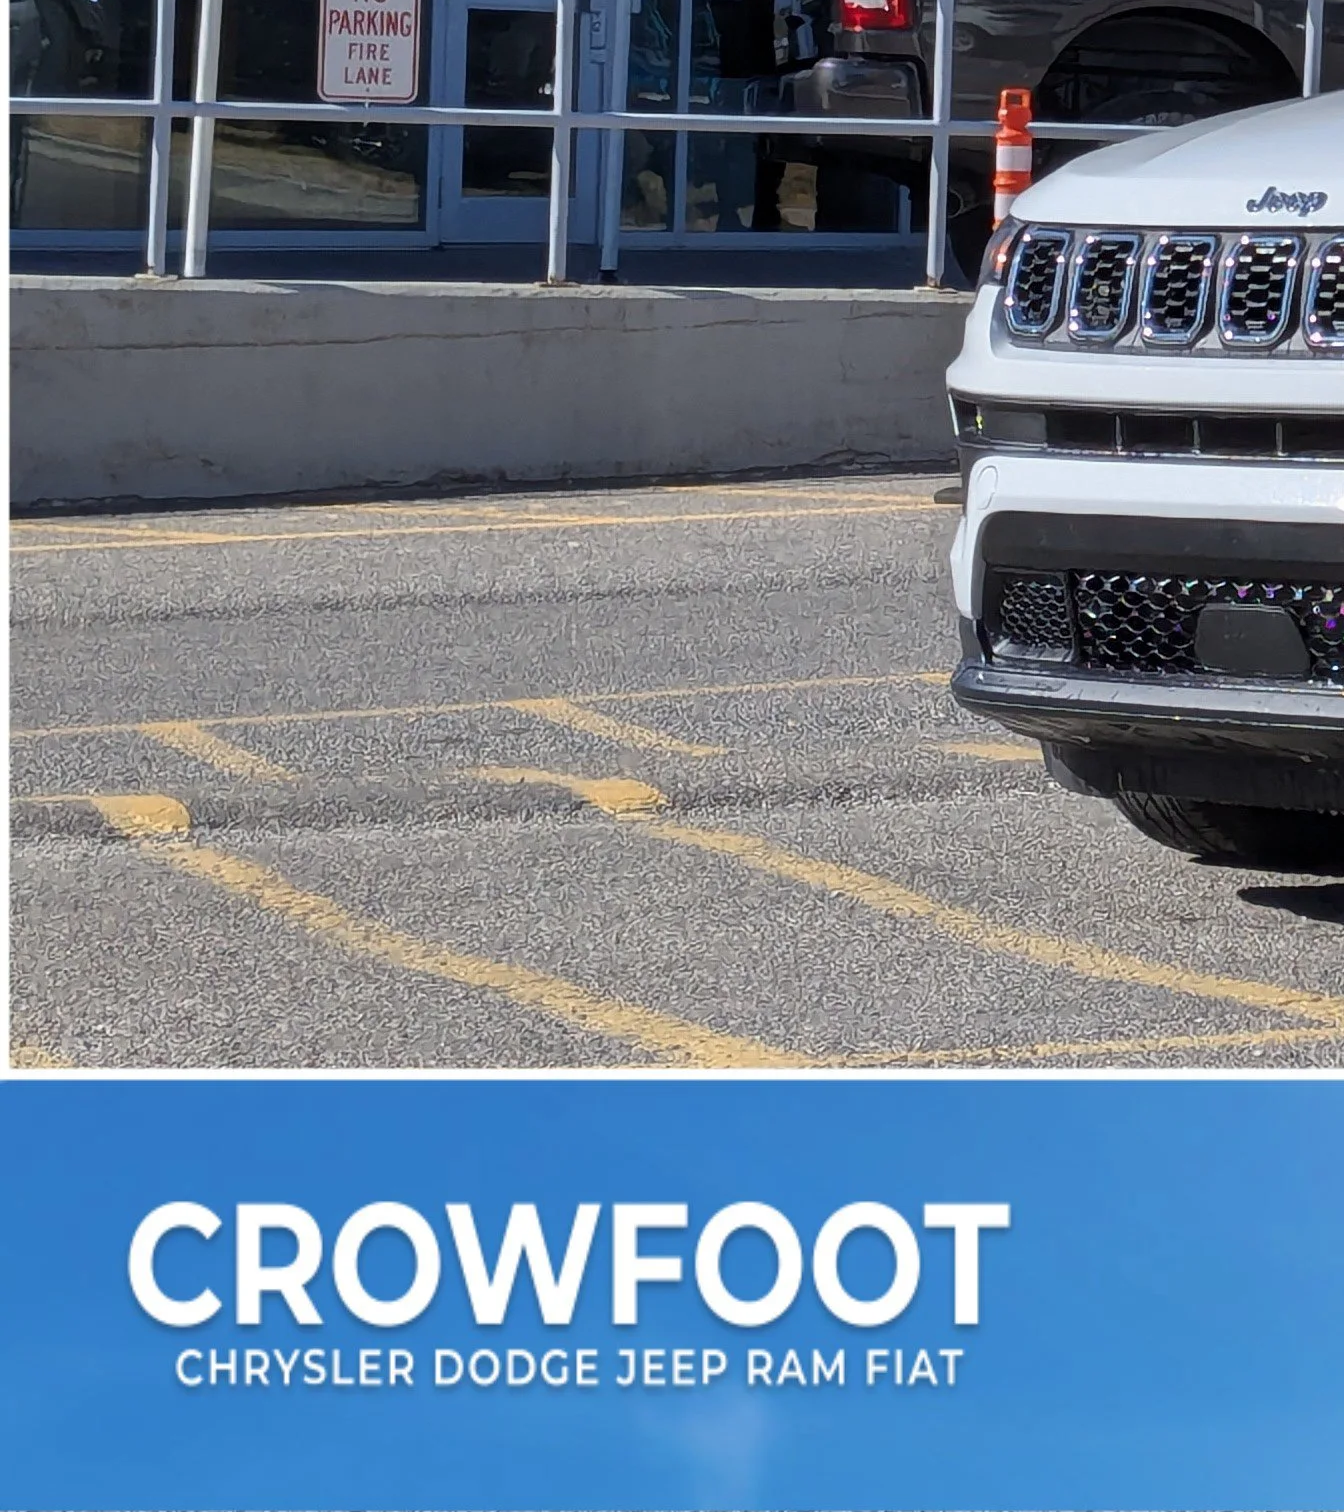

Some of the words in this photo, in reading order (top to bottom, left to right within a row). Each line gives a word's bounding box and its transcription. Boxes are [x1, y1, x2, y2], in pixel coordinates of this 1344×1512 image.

[328, 9, 412, 37] PARKING
[348, 43, 390, 61] FIRE
[344, 67, 392, 85] LANE
[1246, 186, 1328, 217] Jeep
